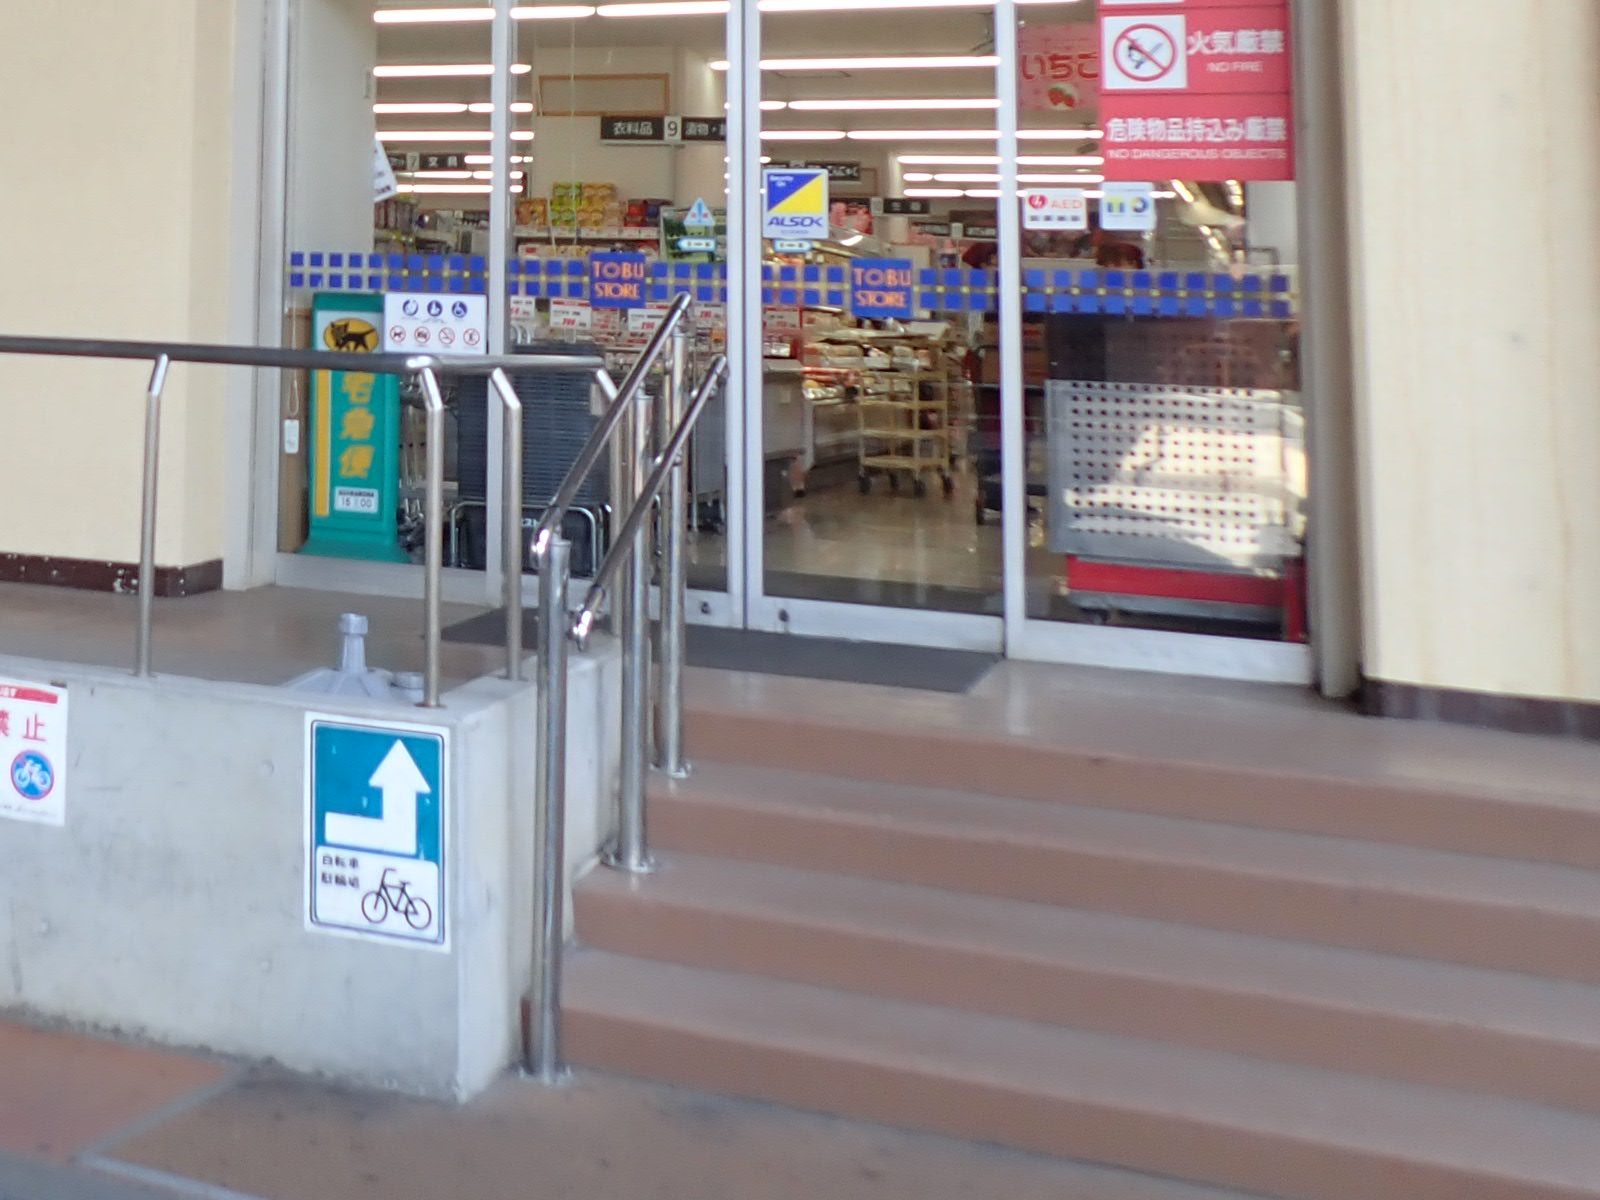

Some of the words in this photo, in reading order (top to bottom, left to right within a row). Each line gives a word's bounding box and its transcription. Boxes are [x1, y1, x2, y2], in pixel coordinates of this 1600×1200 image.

[667, 120, 678, 137] 9
[768, 216, 824, 228] ALSOK
[592, 260, 645, 279] TOBU
[853, 266, 913, 287] TOBU
[594, 281, 641, 299] STORE
[855, 290, 908, 308] STORE
